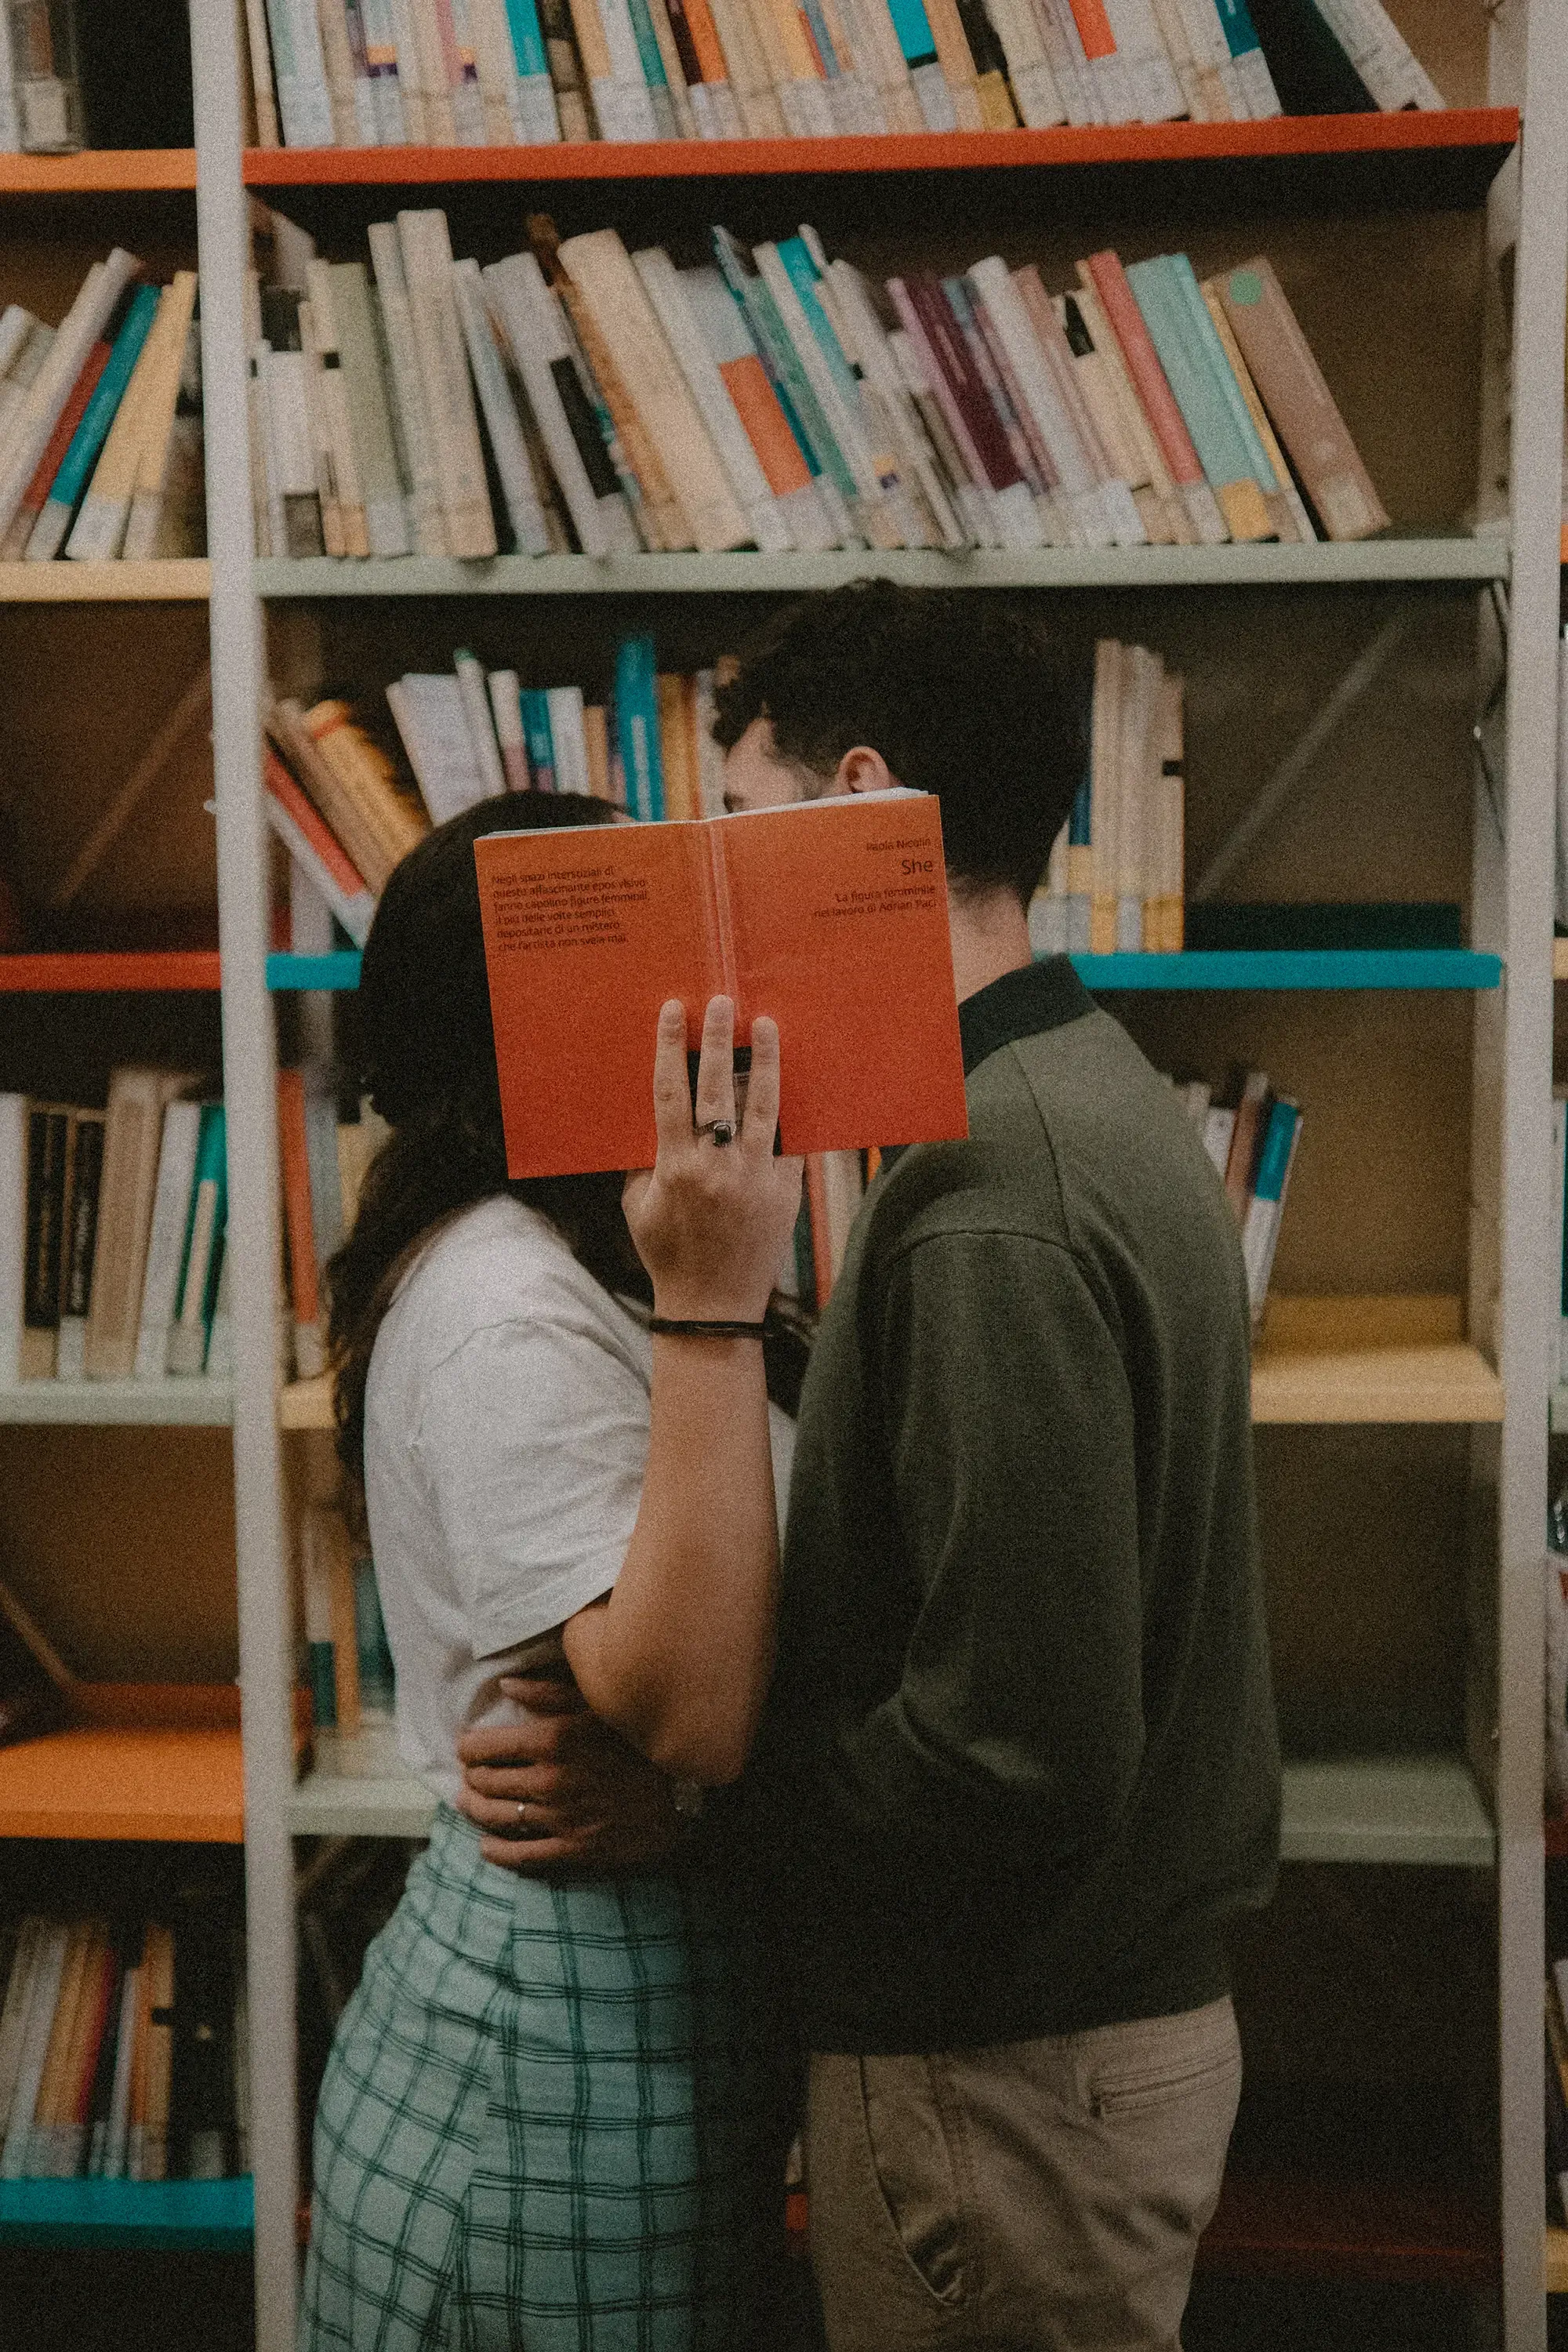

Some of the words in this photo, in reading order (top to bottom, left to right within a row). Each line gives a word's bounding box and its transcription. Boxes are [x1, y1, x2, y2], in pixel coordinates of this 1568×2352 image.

[866, 840, 894, 851] Paola
[902, 858, 933, 875] She
[520, 873, 546, 885] spazi
[548, 868, 601, 880] interstiziali
[604, 866, 614, 875] di
[493, 888, 527, 899] questo
[530, 882, 590, 895] affascinante
[593, 881, 615, 893] epos
[619, 879, 646, 888] visivo
[835, 893, 848, 902] La
[851, 891, 881, 902] figura
[884, 884, 935, 898] femminile
[494, 902, 523, 913] fanno
[525, 898, 568, 911] capolino
[570, 895, 599, 908] figure
[832, 906, 864, 916] lavoro
[867, 903, 877, 913] di
[879, 901, 912, 913] Adrian
[496, 915, 502, 924] il
[522, 911, 545, 924] delle
[547, 910, 572, 920] volte
[497, 927, 551, 938] depositarie
[554, 924, 564, 933] di
[582, 921, 620, 931] mistero
[499, 941, 516, 952] che
[558, 938, 577, 947] non
[580, 936, 604, 945] svela
